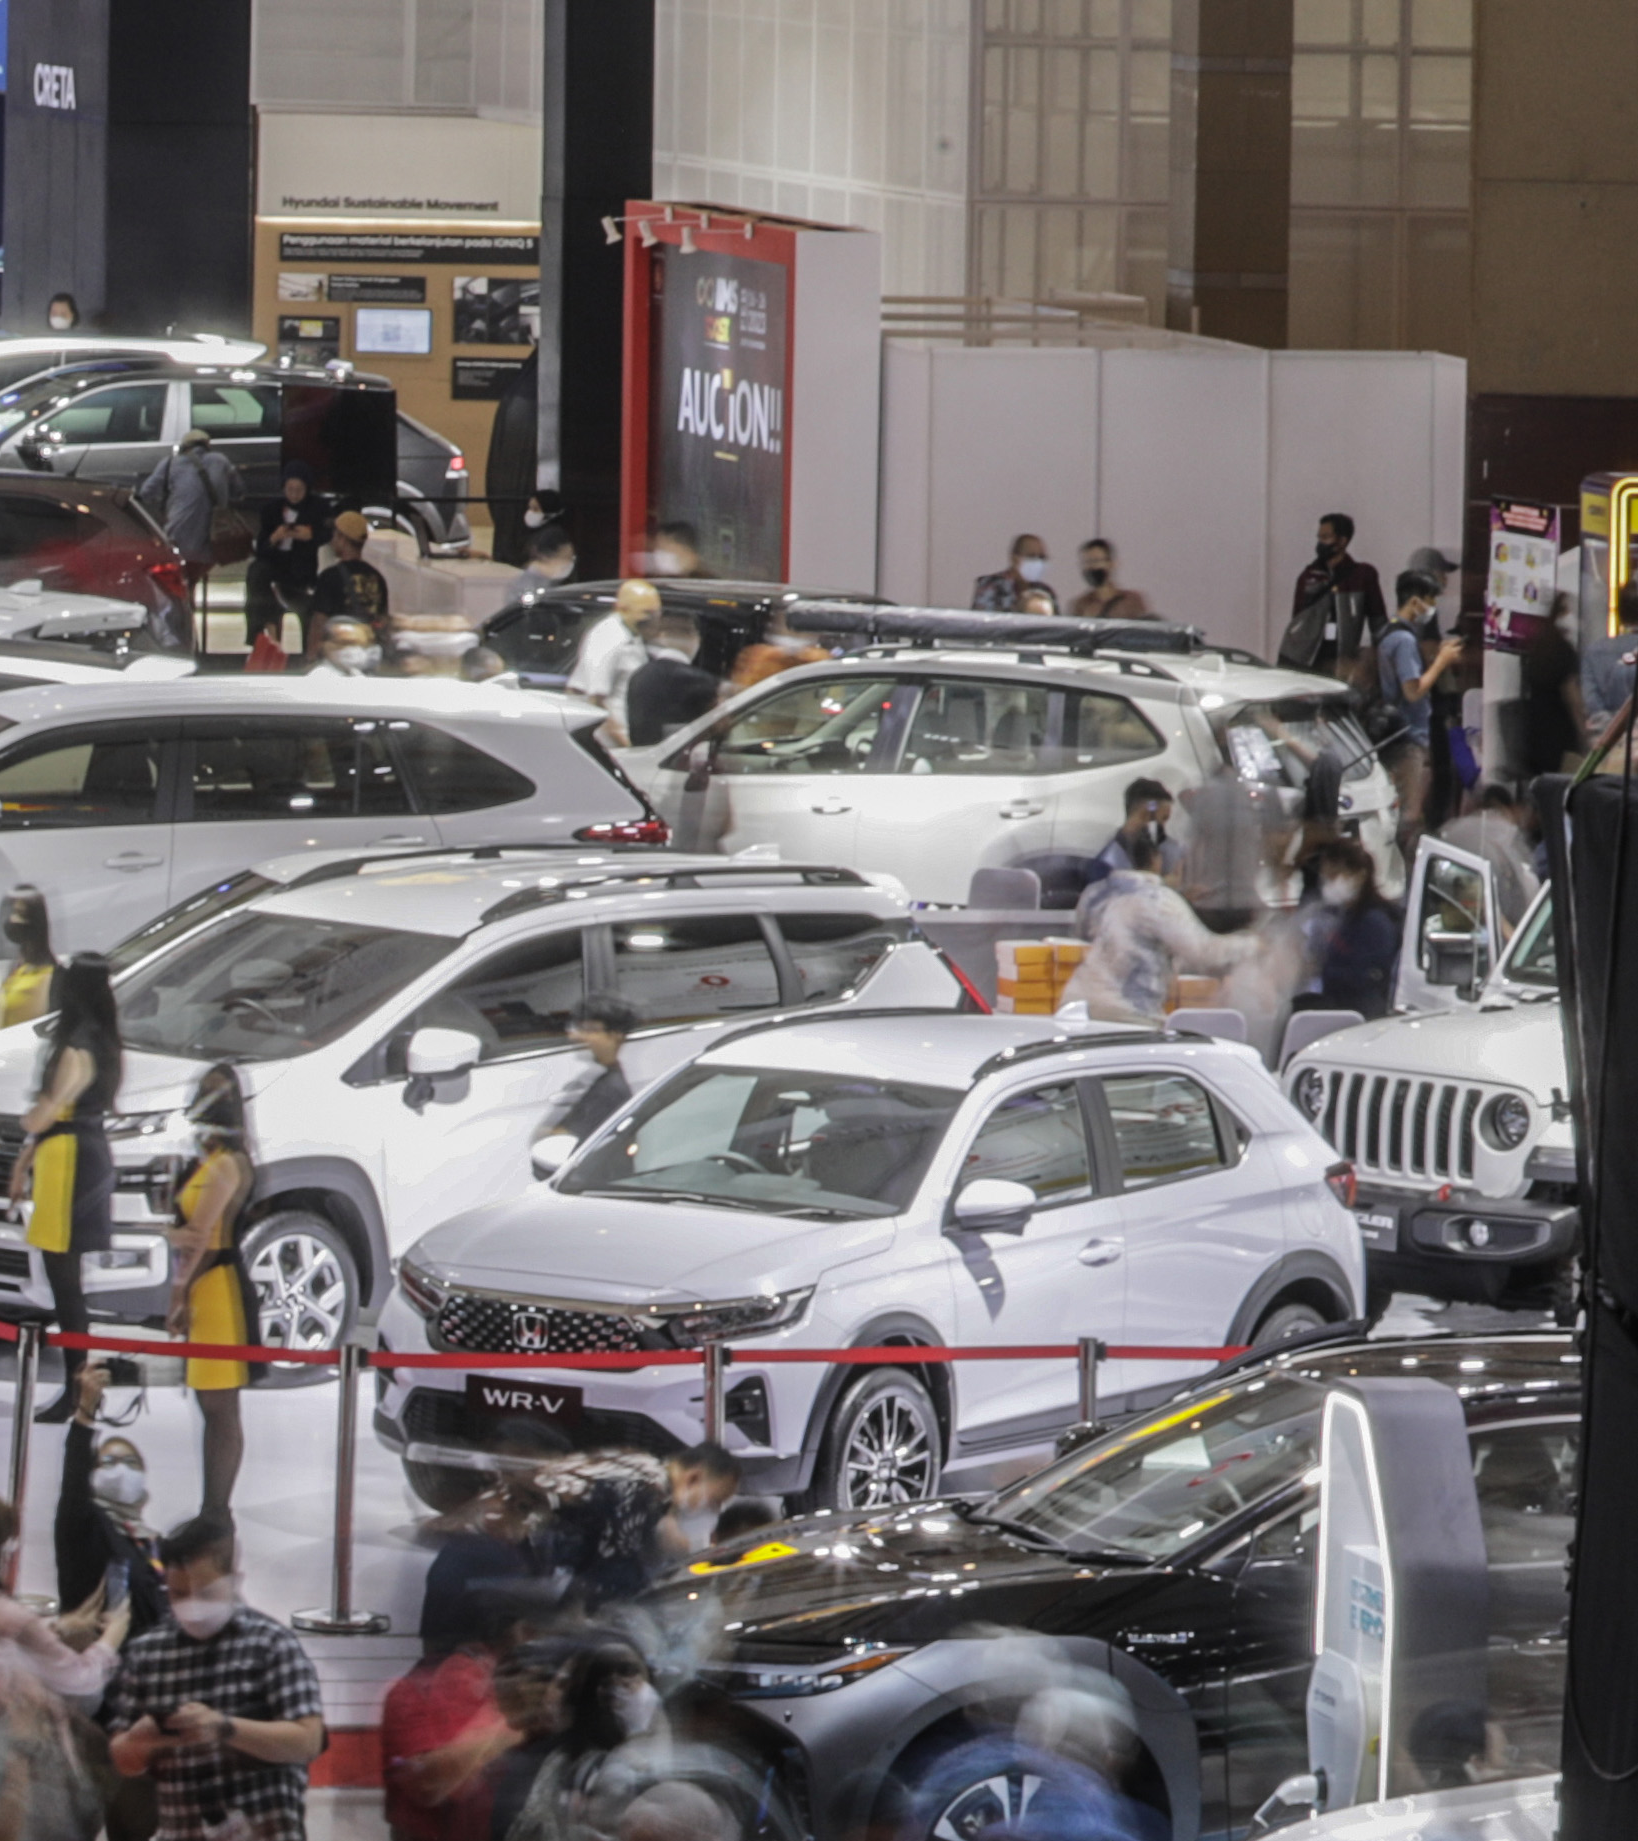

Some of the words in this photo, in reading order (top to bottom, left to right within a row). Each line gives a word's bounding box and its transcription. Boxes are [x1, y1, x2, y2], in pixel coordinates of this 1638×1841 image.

[34, 63, 76, 111] CRETA
[282, 196, 341, 210] Hyundai
[343, 197, 423, 210] Sustainable
[426, 199, 499, 212] Movement
[483, 1387, 564, 1414] WR-V
